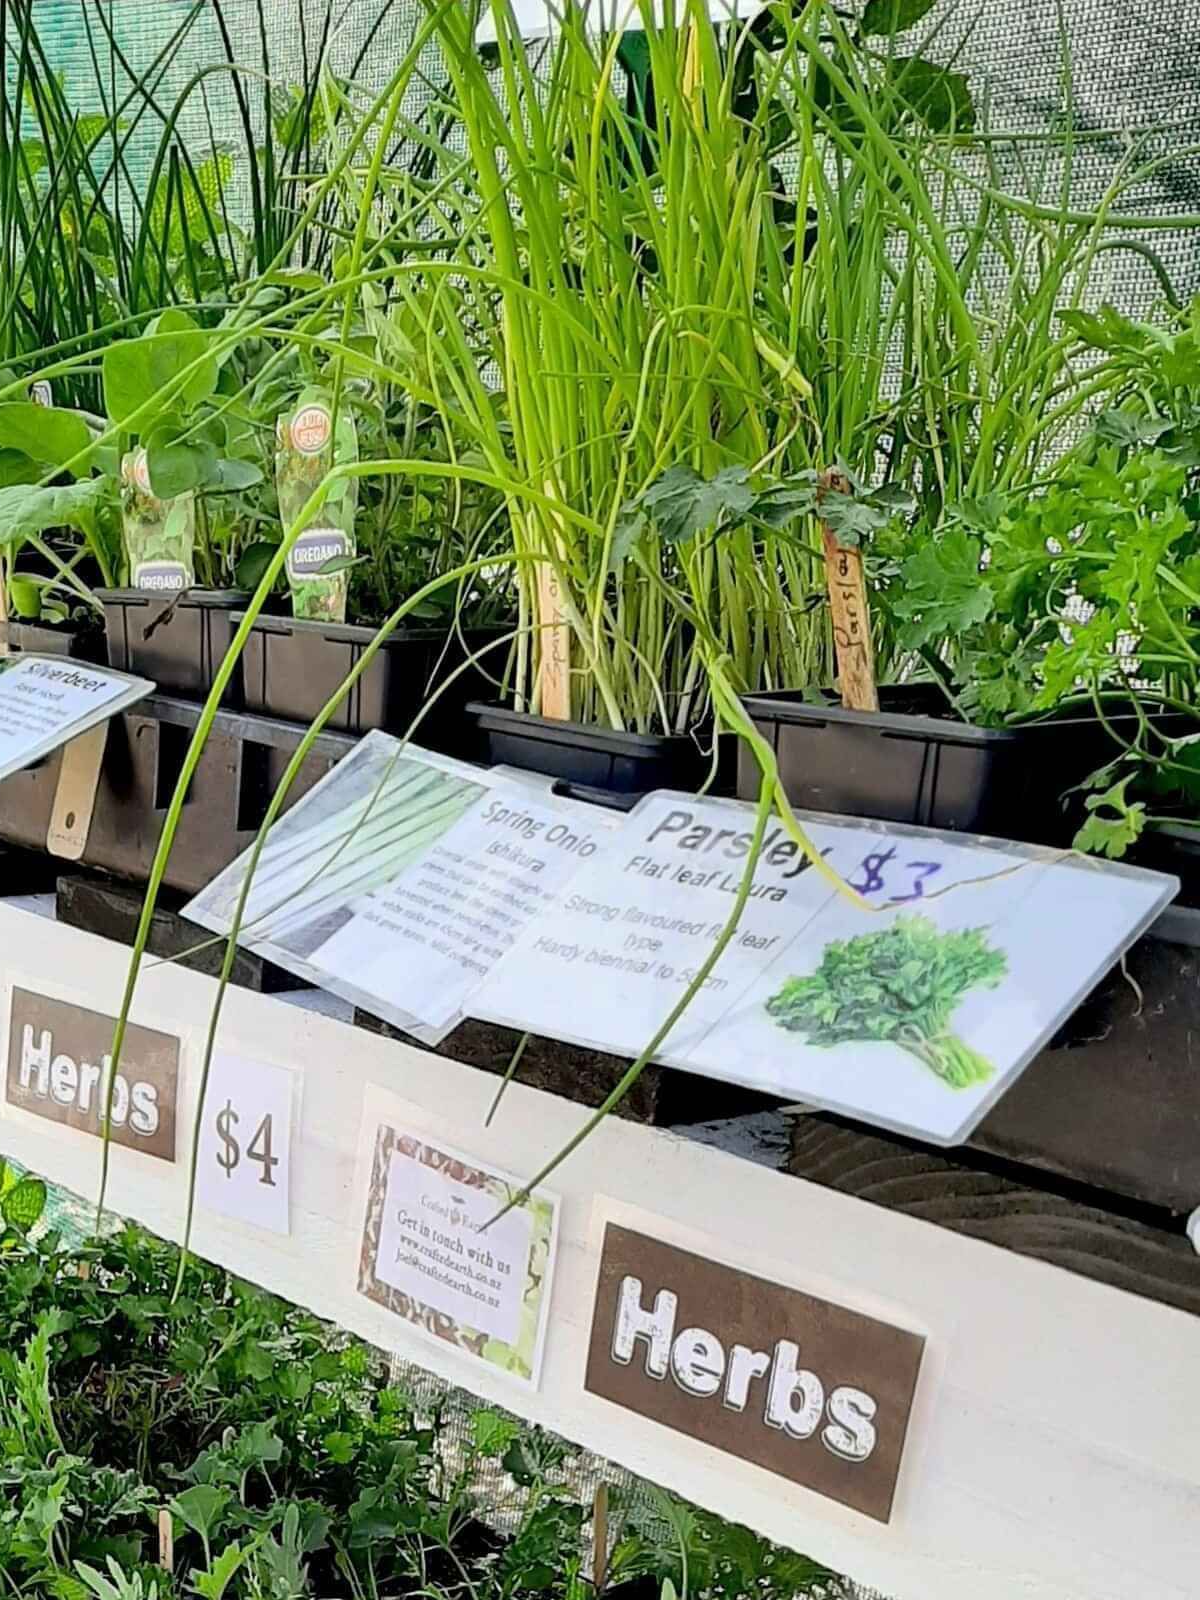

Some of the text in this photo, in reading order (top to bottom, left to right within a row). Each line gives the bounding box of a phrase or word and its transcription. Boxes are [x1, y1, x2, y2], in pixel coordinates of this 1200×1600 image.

[22, 663, 108, 692] Silverbeet
[481, 800, 597, 857] Spring Onio
[486, 841, 546, 872] Ishikura
[645, 810, 833, 880] Parsley
[624, 856, 673, 882] Flat
[677, 864, 719, 890] leaf
[564, 895, 780, 951] Strong flavoured fl leaf
[624, 932, 663, 954] type
[532, 936, 582, 961] Hardy
[583, 945, 655, 974] biennial
[656, 963, 675, 980] to
[18, 1023, 160, 1137] Herbs
[216, 1099, 279, 1187] $4
[397, 1209, 512, 1277] Get in touch with us
[399, 1233, 503, 1291] www.craftedearth.co.nz
[611, 1274, 878, 1462] Herbs
